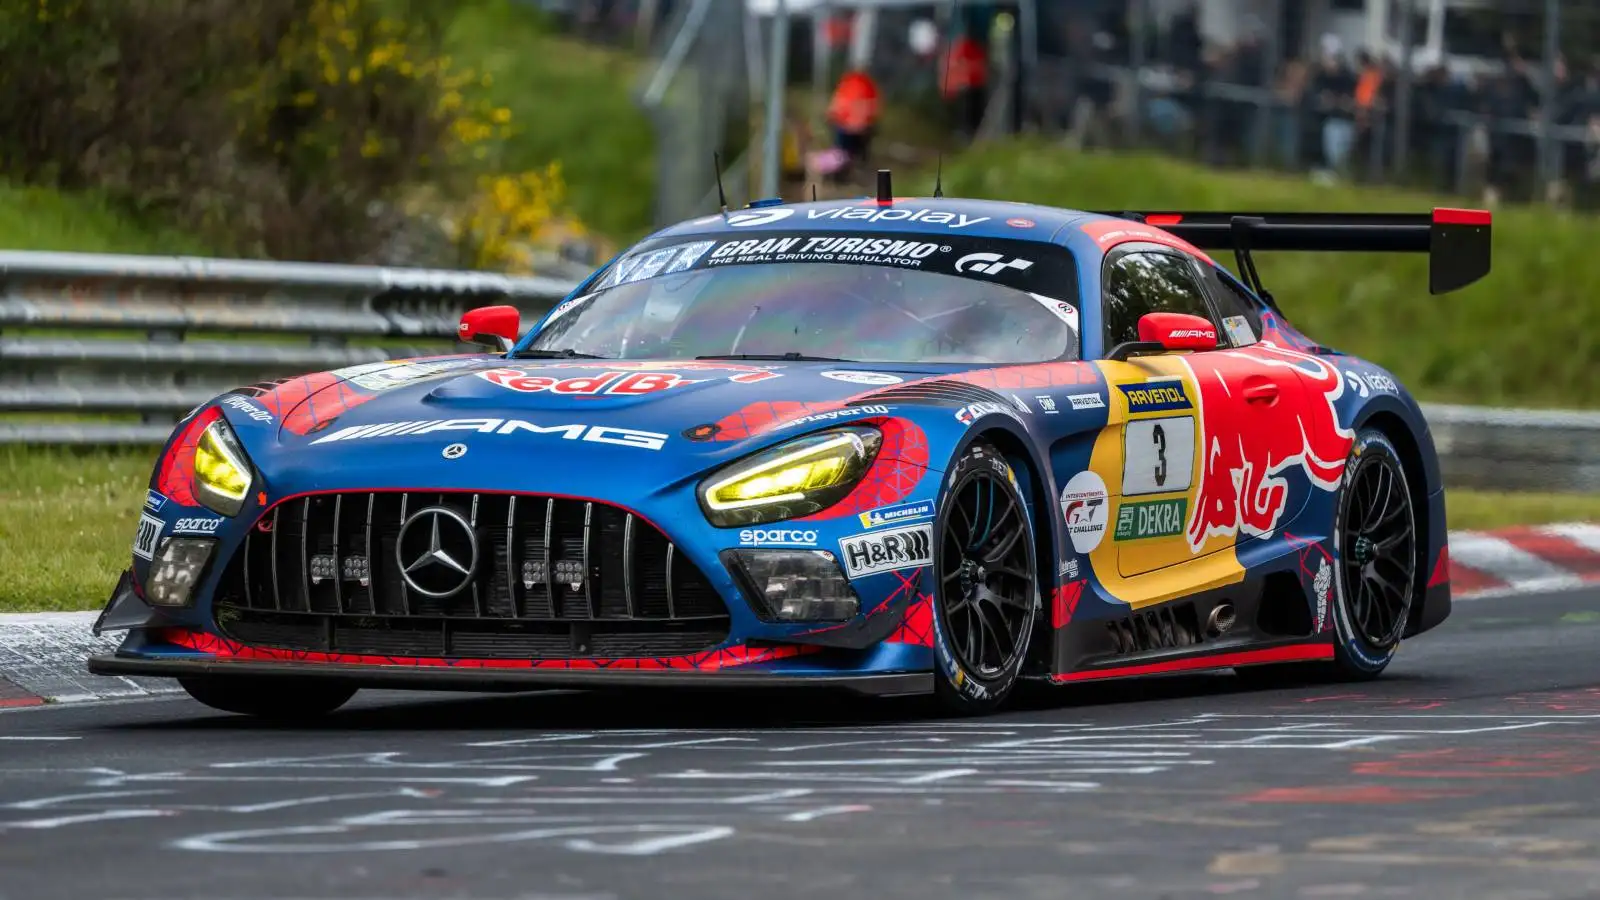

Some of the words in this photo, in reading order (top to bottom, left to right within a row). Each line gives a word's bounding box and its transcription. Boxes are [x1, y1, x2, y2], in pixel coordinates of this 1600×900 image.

[806, 206, 991, 228] viaplay
[711, 237, 801, 258] GRAN
[800, 237, 938, 259] TURISMO
[707, 257, 733, 265] THE
[734, 254, 774, 262] REAL
[837, 253, 922, 267] SIMULATOR
[1361, 371, 1399, 394] viaplay
[1128, 387, 1185, 405] RAVENOL
[793, 407, 860, 424] Player
[410, 419, 670, 450] AMG
[1153, 424, 1167, 486] 3
[1065, 490, 1104, 498] INTERCONTINENTAL
[884, 505, 928, 519] MICHELIN
[1138, 503, 1180, 535] DEKRA
[173, 517, 219, 533] sparco
[1073, 524, 1103, 534] CHALLENGE
[740, 530, 817, 546] sparco
[847, 535, 903, 568] H&R
